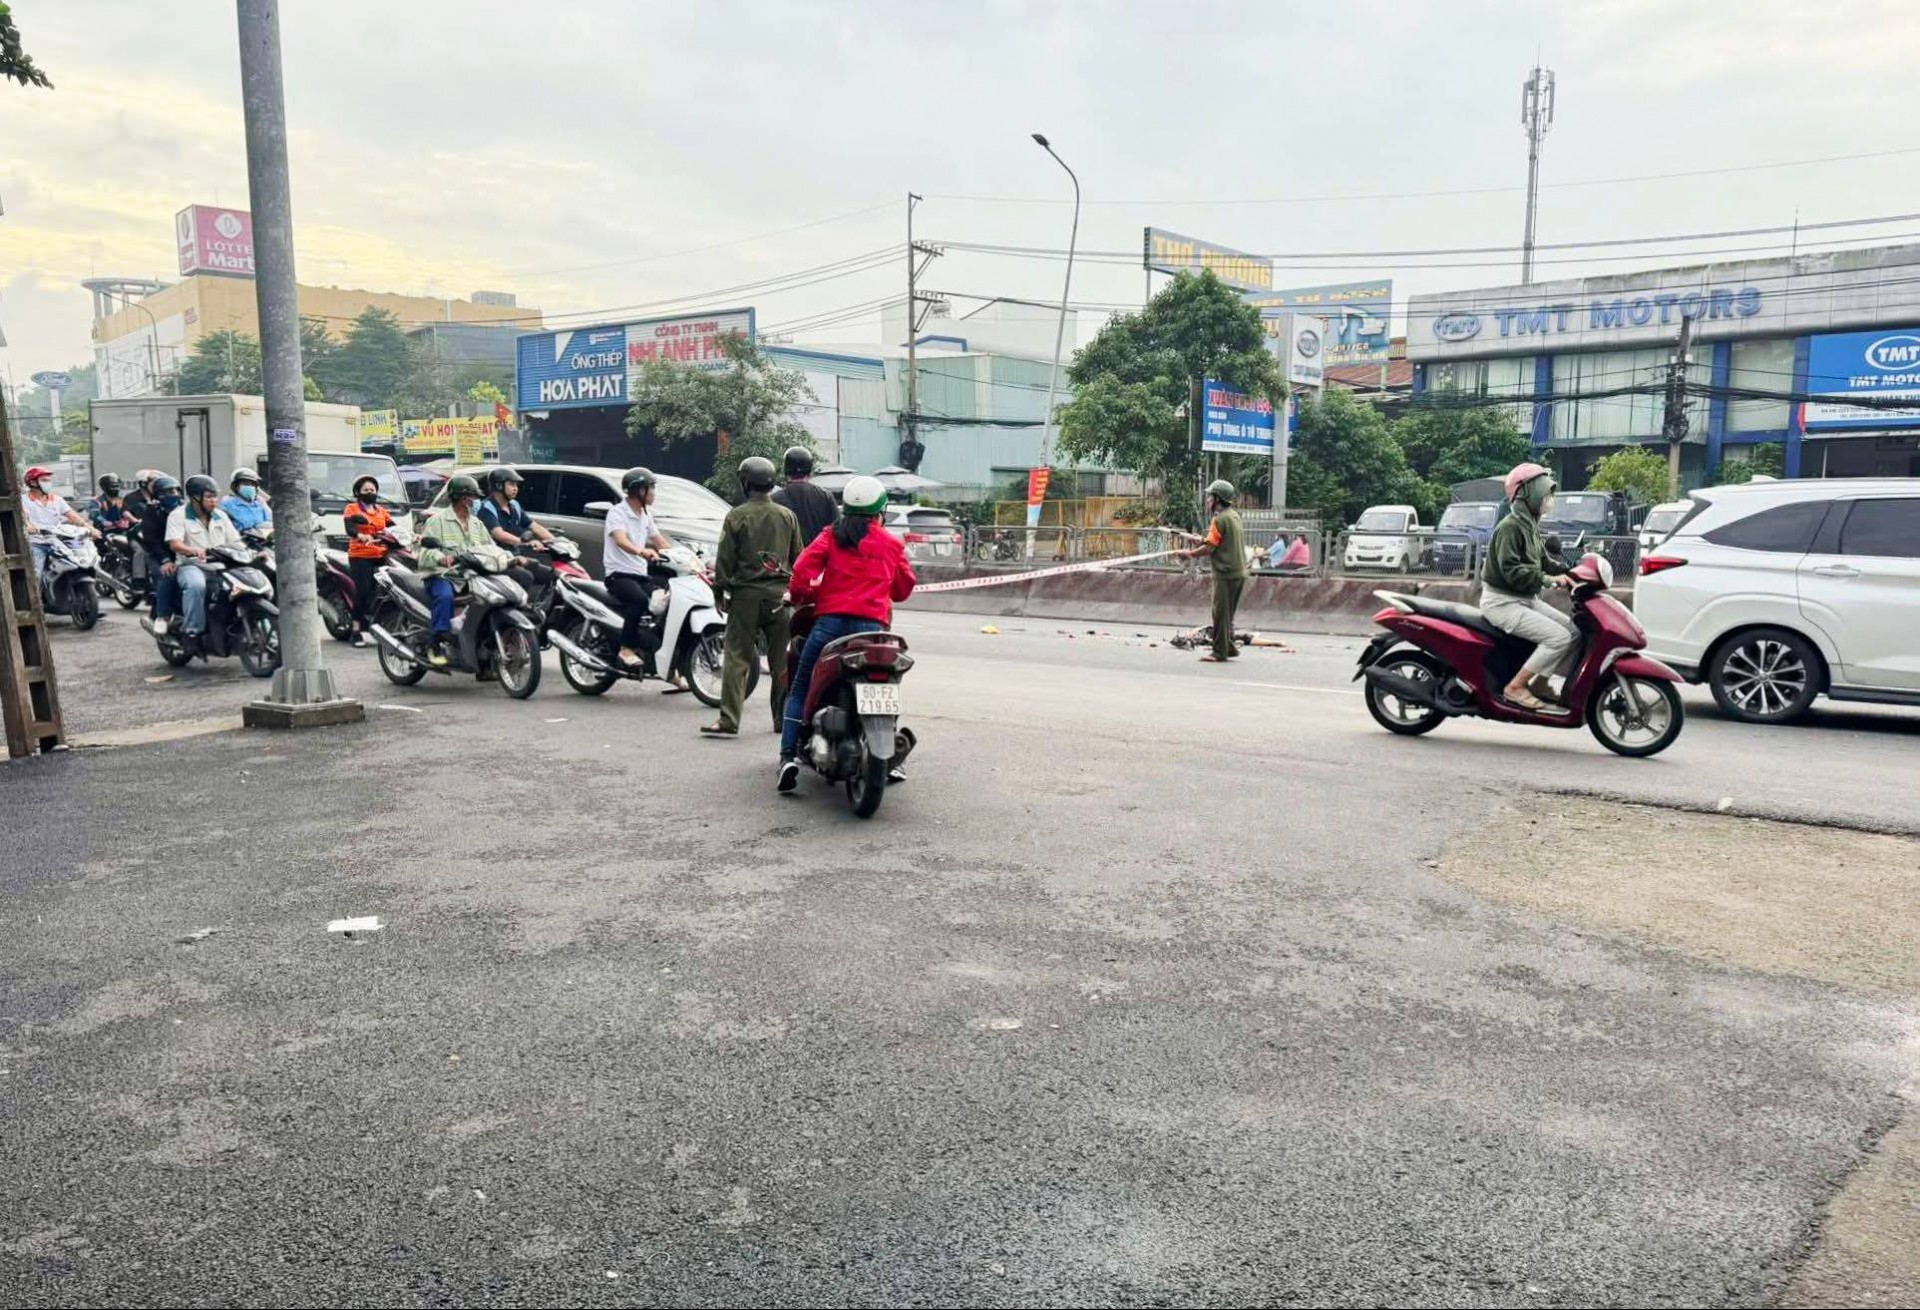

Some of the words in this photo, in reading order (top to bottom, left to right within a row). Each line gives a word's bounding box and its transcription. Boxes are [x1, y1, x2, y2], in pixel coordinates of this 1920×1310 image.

[206, 240, 254, 254] LOTTE
[208, 252, 255, 271] Mart
[1495, 304, 1572, 337] TMT
[1589, 287, 1763, 329] MOTORS
[598, 348, 623, 368] THÉP
[1878, 345, 1920, 362] TMT
[1848, 375, 1879, 388] TMT
